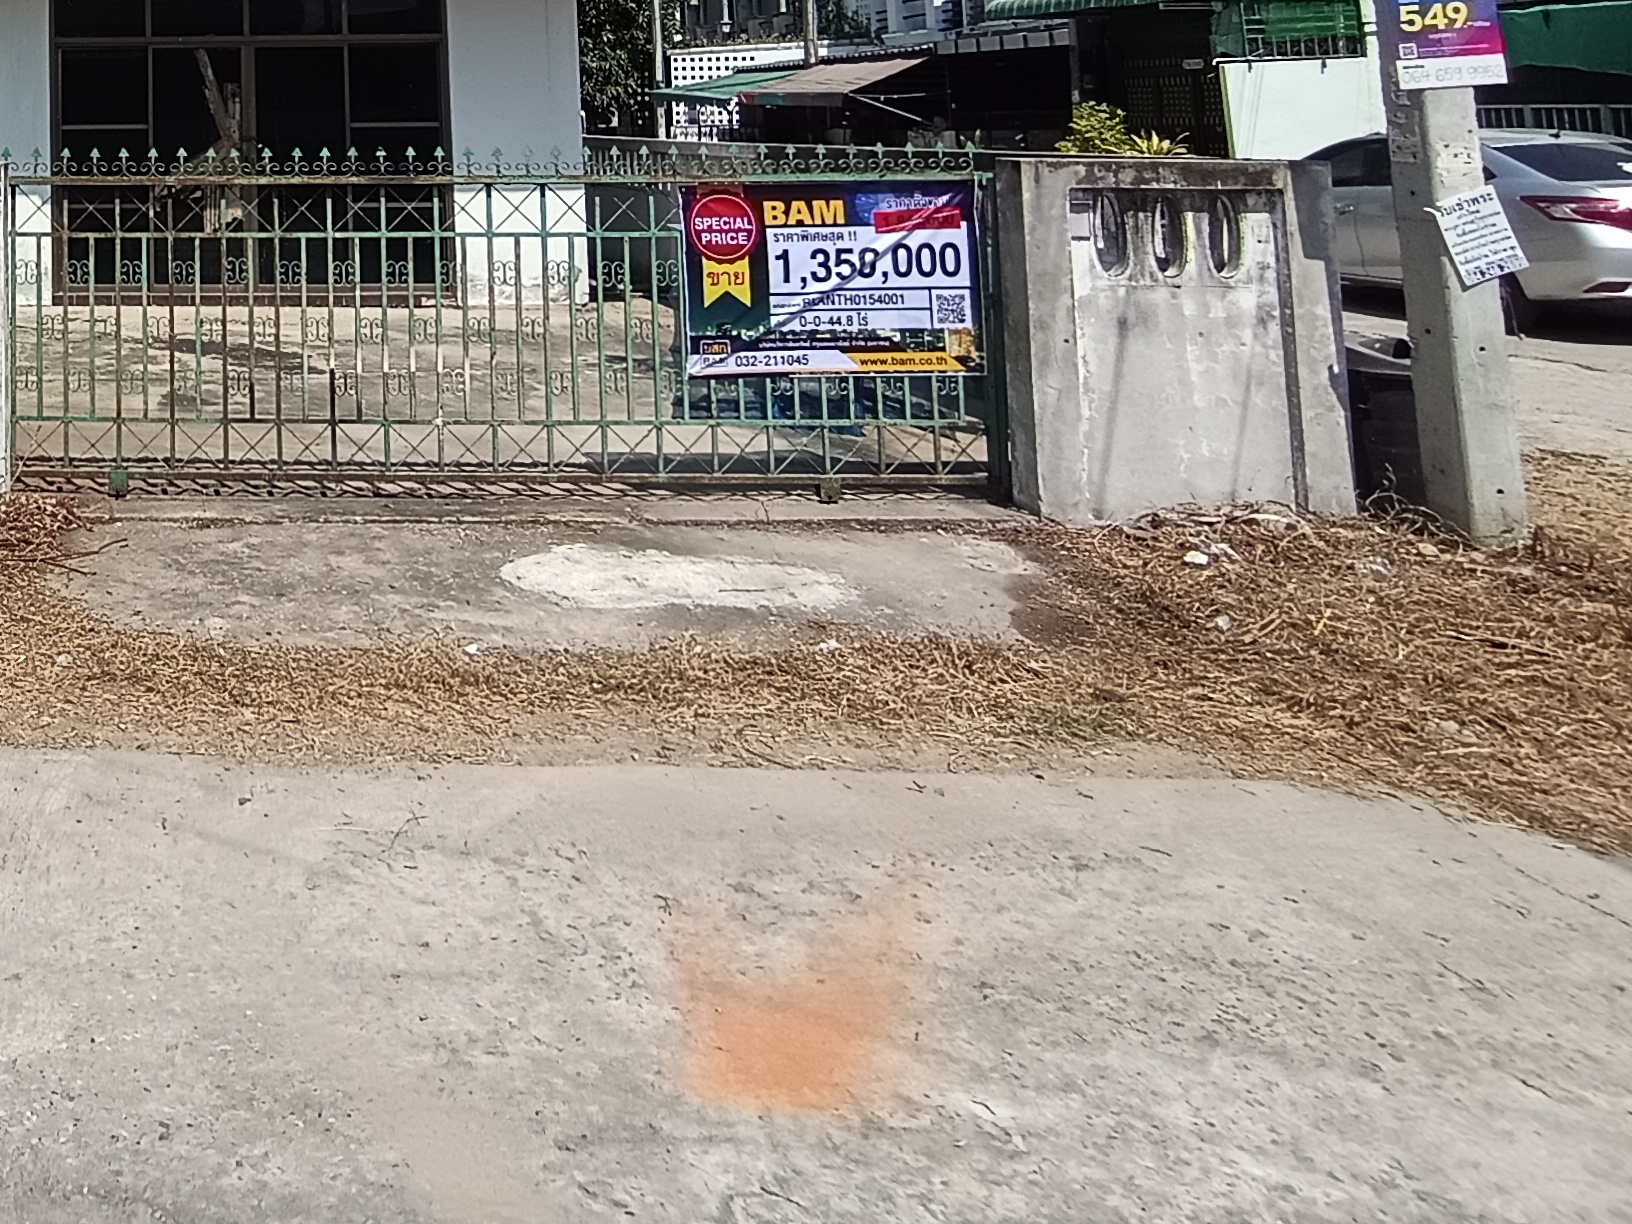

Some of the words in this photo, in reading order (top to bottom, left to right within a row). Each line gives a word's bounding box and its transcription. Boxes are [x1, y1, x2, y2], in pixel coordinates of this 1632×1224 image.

[762, 200, 846, 225] BAM
[694, 217, 753, 230] SPECIAL
[701, 232, 748, 245] PRICE
[773, 230, 845, 246] ราคาพิเศษสุด
[774, 241, 962, 291] 1,350,000
[706, 271, 745, 287] ขาย
[799, 315, 854, 328] 0-0-44.8
[857, 311, 869, 327] ไร่
[734, 354, 810, 367] 032-211045
[859, 355, 948, 367] www.bam.co.th
